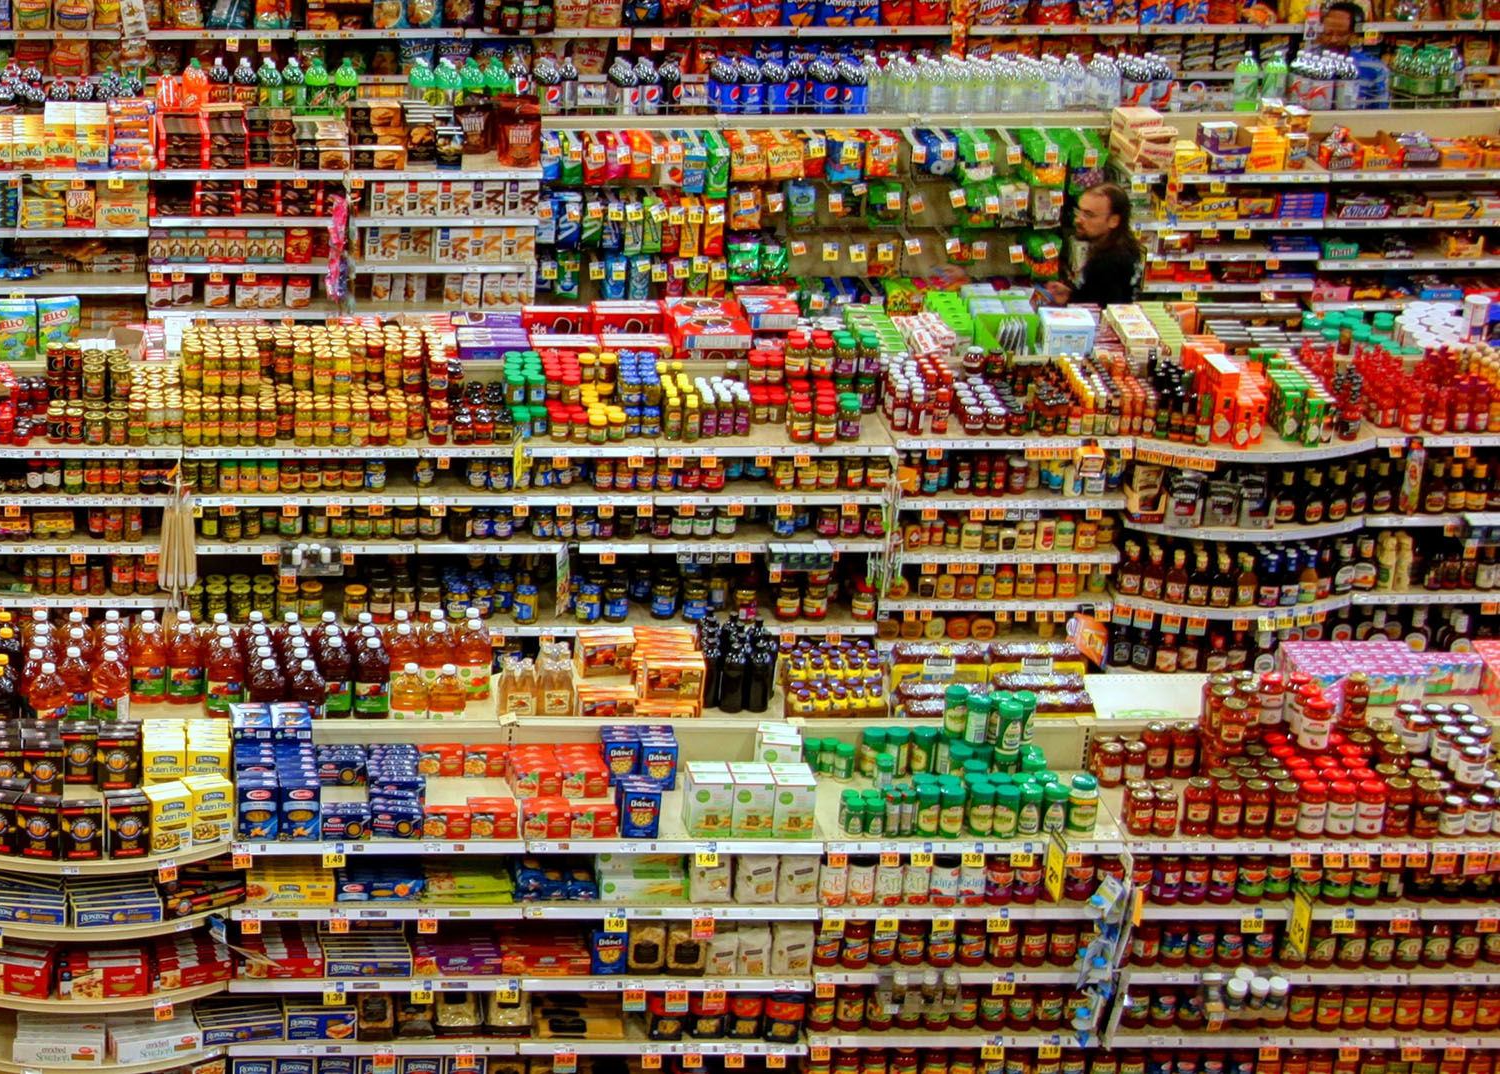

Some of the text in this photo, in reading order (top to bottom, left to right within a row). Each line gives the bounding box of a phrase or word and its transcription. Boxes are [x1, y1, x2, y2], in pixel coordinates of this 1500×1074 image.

[1343, 206, 1388, 218] SNICKERS
[42, 310, 68, 322] JELL-O
[155, 813, 176, 822] Gluten
[234, 857, 249, 865] 2.19
[332, 922, 347, 930] 2.19
[695, 920, 713, 928] 2.60
[458, 1057, 473, 1065] 2.19
